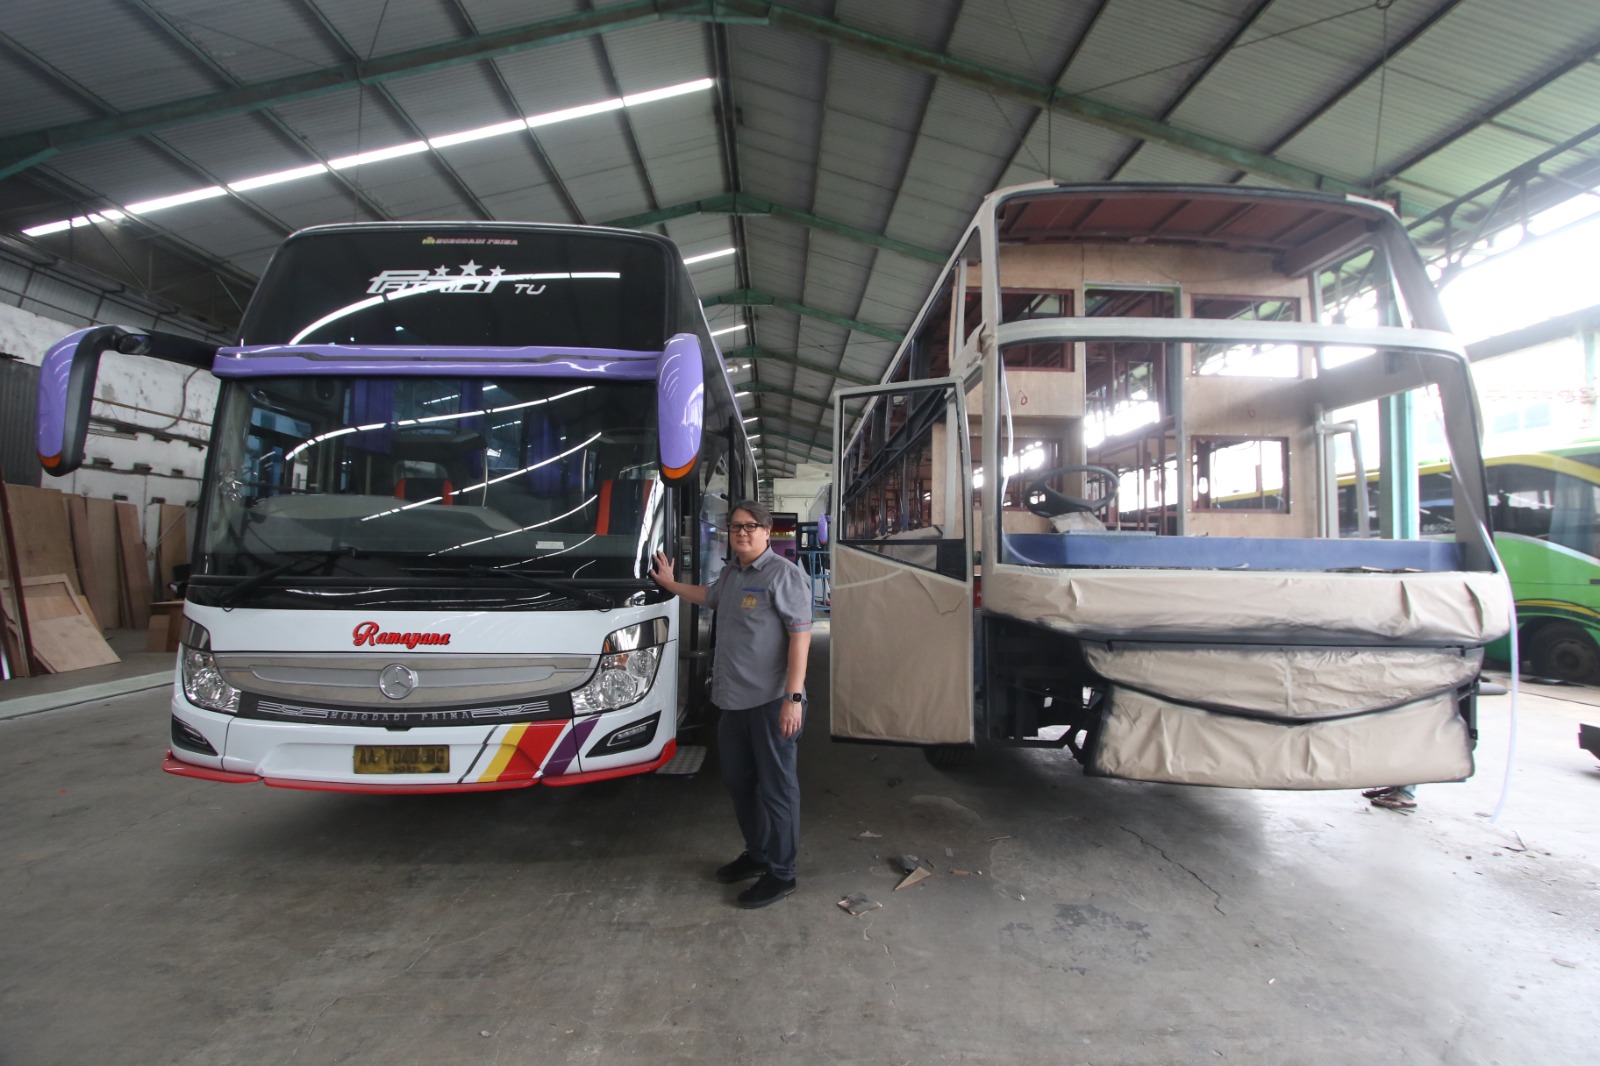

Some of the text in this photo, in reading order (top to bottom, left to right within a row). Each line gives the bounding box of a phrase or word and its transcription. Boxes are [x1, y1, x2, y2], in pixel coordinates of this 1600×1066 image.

[514, 284, 546, 295] TU
[352, 621, 451, 650] Ramayana
[421, 711, 469, 721] PRIMA
